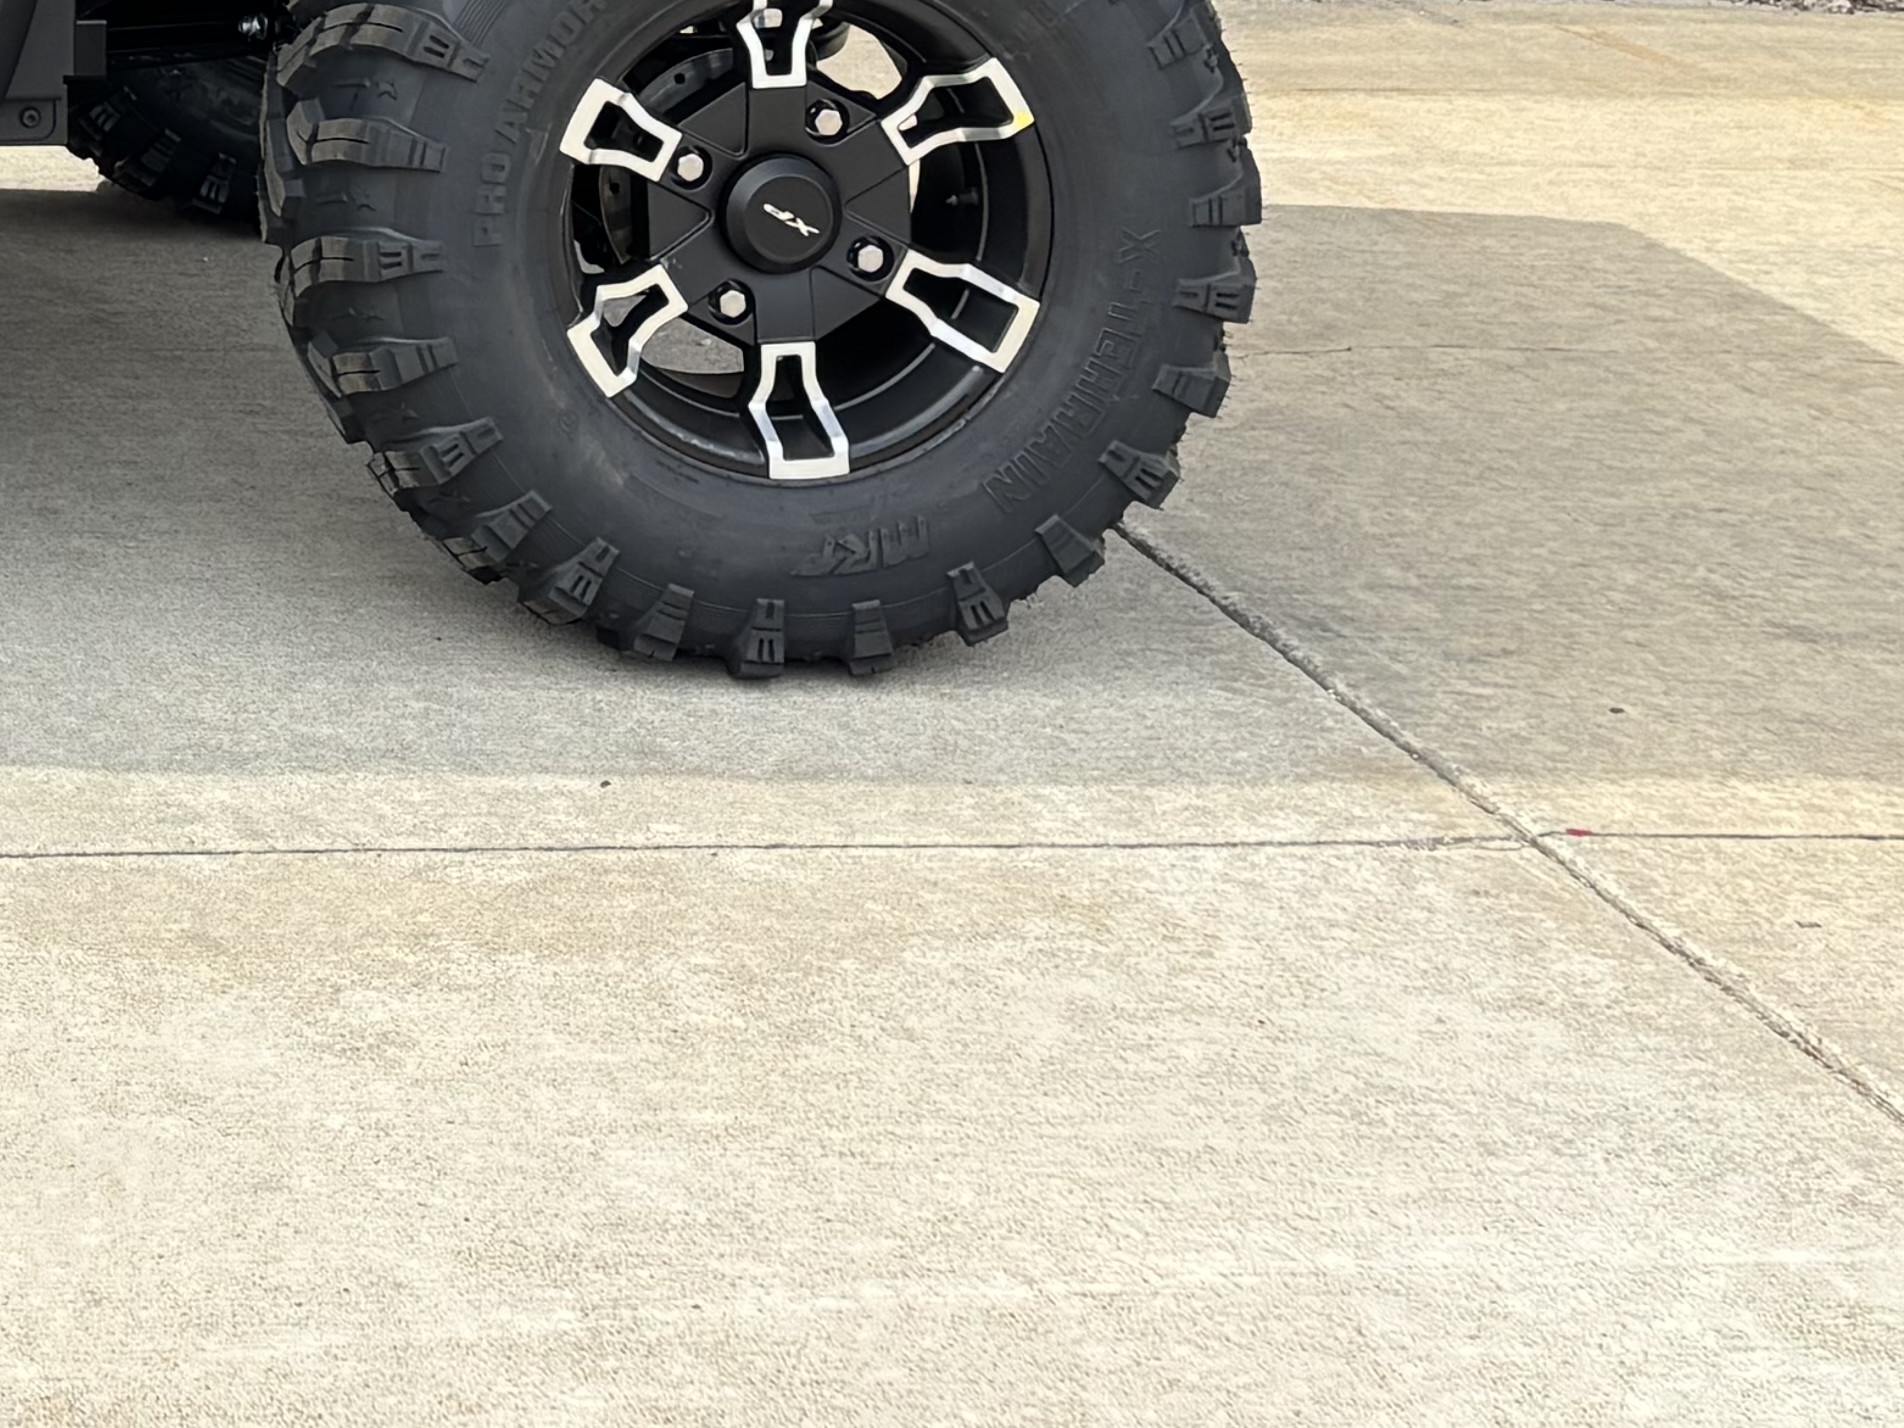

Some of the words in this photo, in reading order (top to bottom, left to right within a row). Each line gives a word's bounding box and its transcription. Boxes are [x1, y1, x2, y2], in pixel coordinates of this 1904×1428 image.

[473, 152, 511, 247] PRO
[763, 204, 820, 237] XP
[981, 228, 1161, 513] X-TERRAIN
